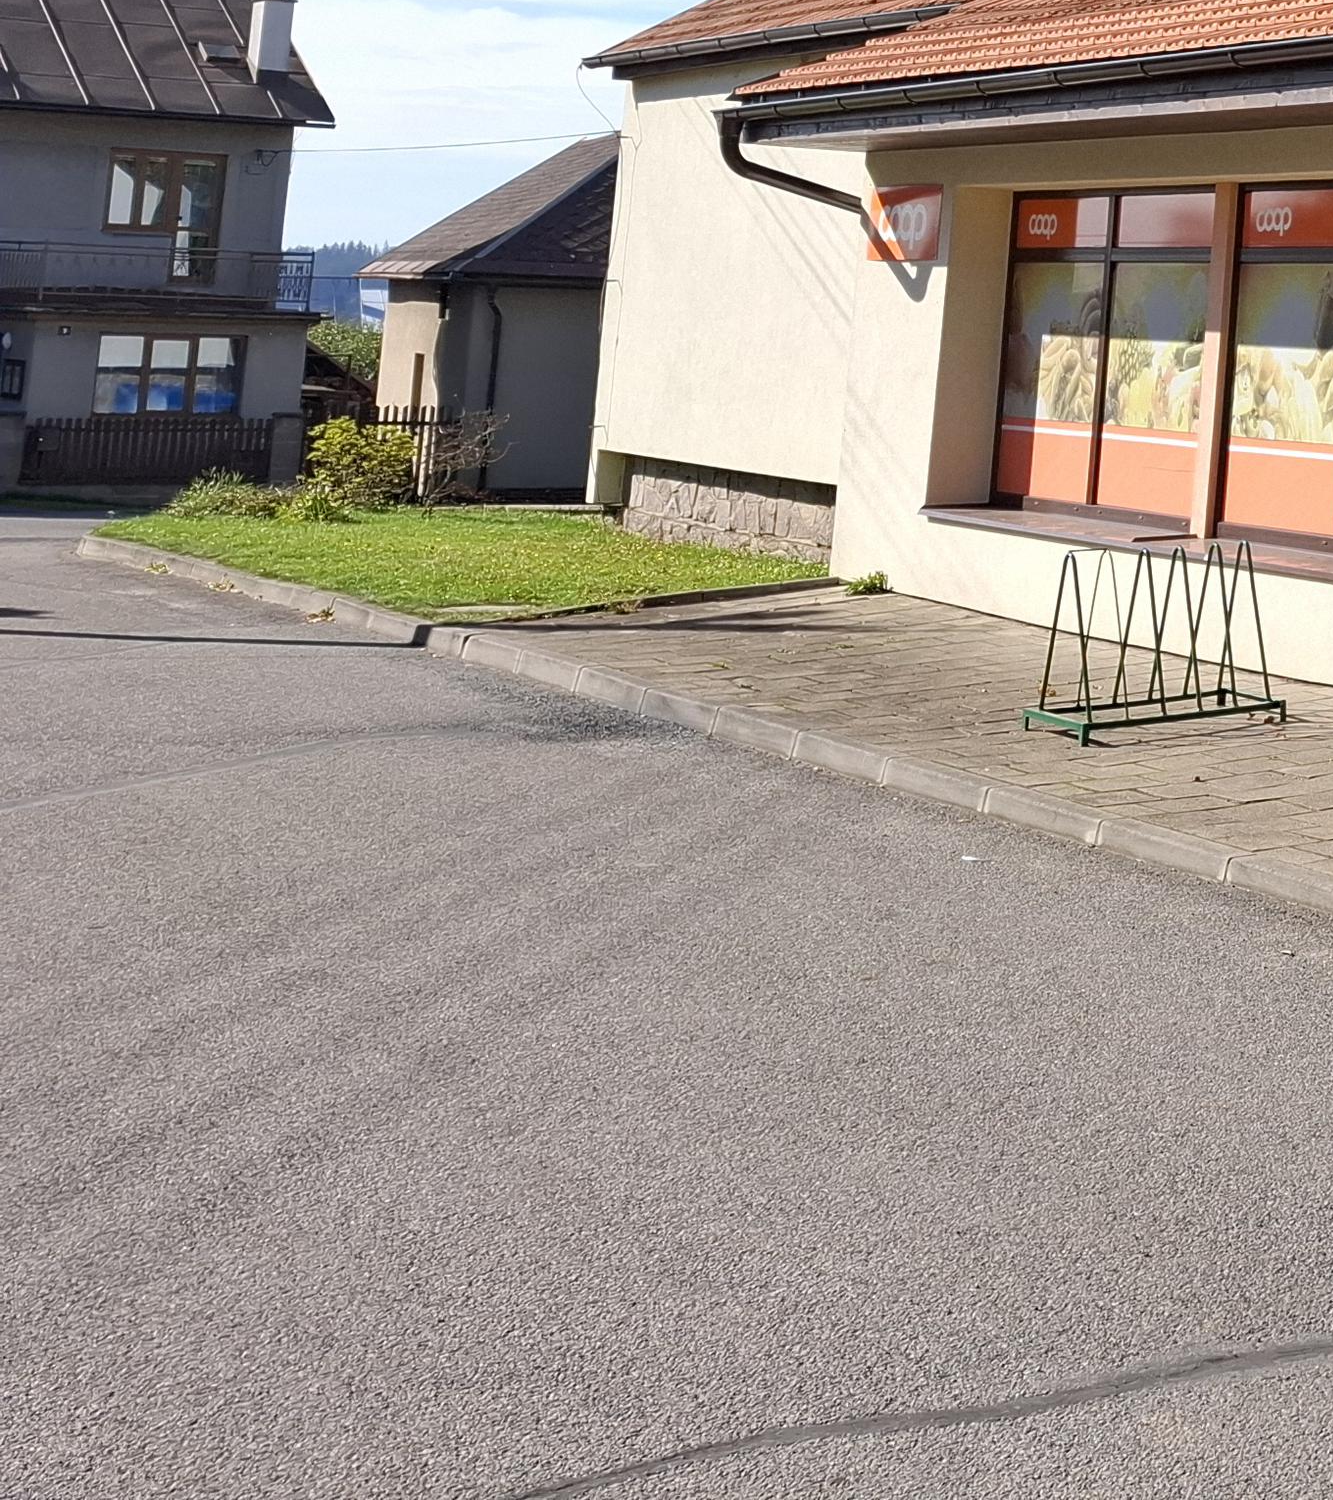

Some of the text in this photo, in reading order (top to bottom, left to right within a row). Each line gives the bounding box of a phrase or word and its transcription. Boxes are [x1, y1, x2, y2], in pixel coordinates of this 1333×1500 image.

[879, 204, 927, 249] coop
[1029, 214, 1057, 240] coop
[1256, 207, 1292, 237] coop
